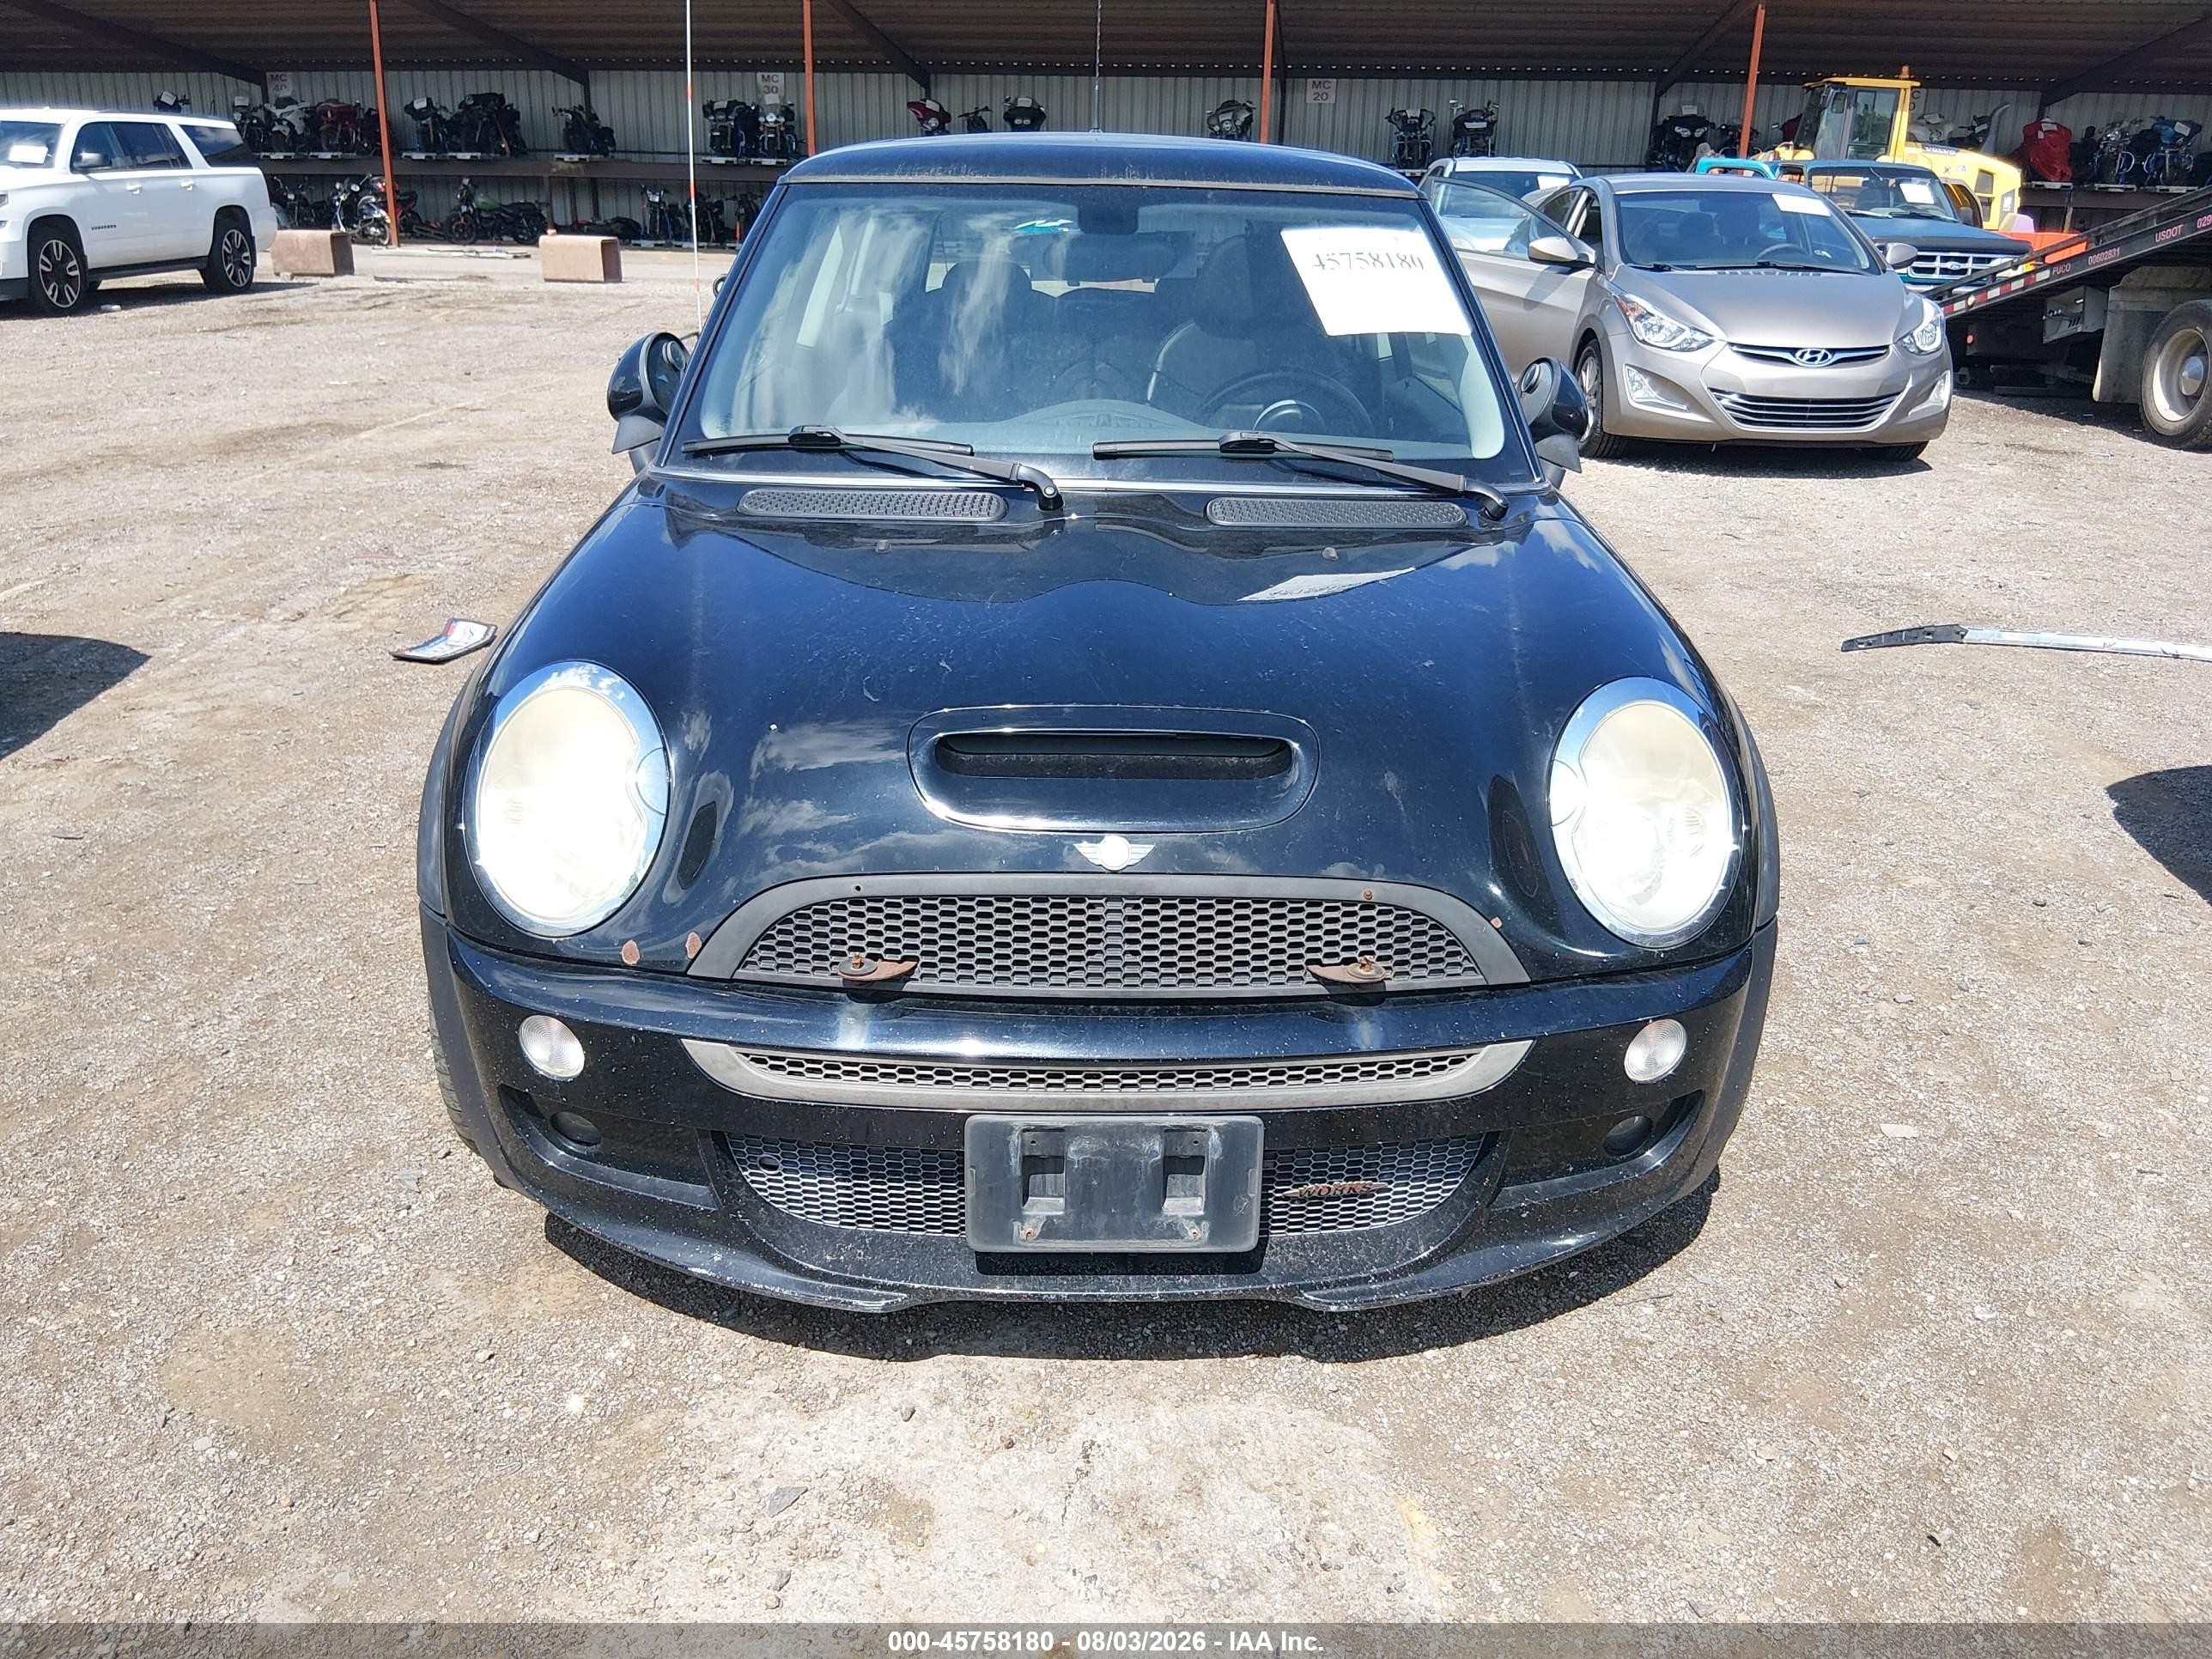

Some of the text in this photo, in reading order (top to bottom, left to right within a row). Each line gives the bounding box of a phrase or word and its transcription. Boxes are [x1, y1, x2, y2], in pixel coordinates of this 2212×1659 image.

[270, 74, 288, 82] MC
[762, 74, 780, 82] MC
[763, 85, 779, 94] 30
[1311, 81, 1332, 89] MC
[1312, 92, 1329, 101] 20
[1924, 146, 1956, 155] VOLVO
[2051, 214, 2212, 276] PUCO 00602831 USDOT 029
[1311, 252, 1425, 270] 45758180
